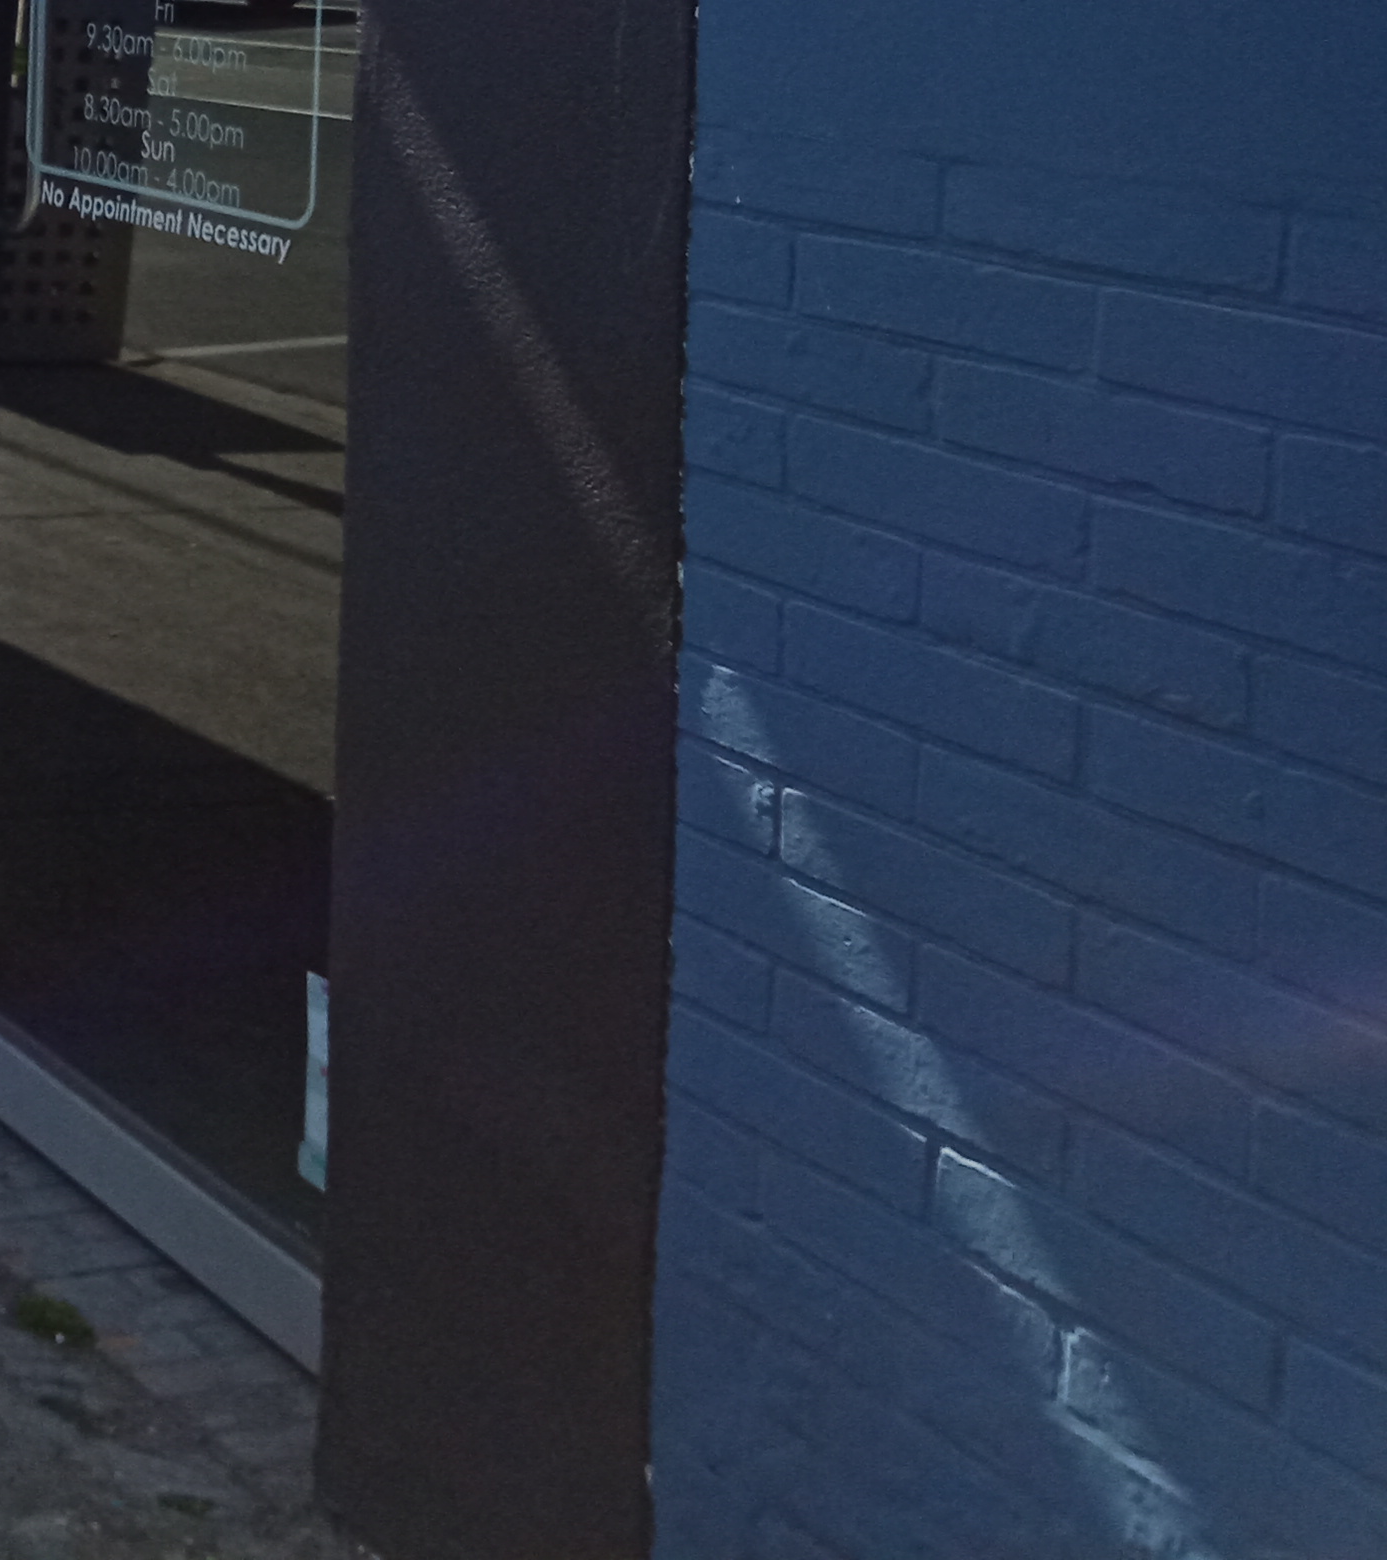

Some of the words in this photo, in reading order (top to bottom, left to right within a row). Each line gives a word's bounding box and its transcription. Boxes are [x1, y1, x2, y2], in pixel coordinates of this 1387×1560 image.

[86, 23, 154, 57] 9.30am
[173, 37, 247, 74] 6.00pm
[147, 67, 177, 96] Sat
[83, 93, 152, 131] 8.30am
[171, 108, 244, 149] 5.00pm
[141, 130, 175, 163] Sun
[166, 167, 241, 209] 4.00pm
[41, 179, 65, 207] No
[69, 186, 183, 235] Appointment
[187, 212, 292, 265] Necessary
